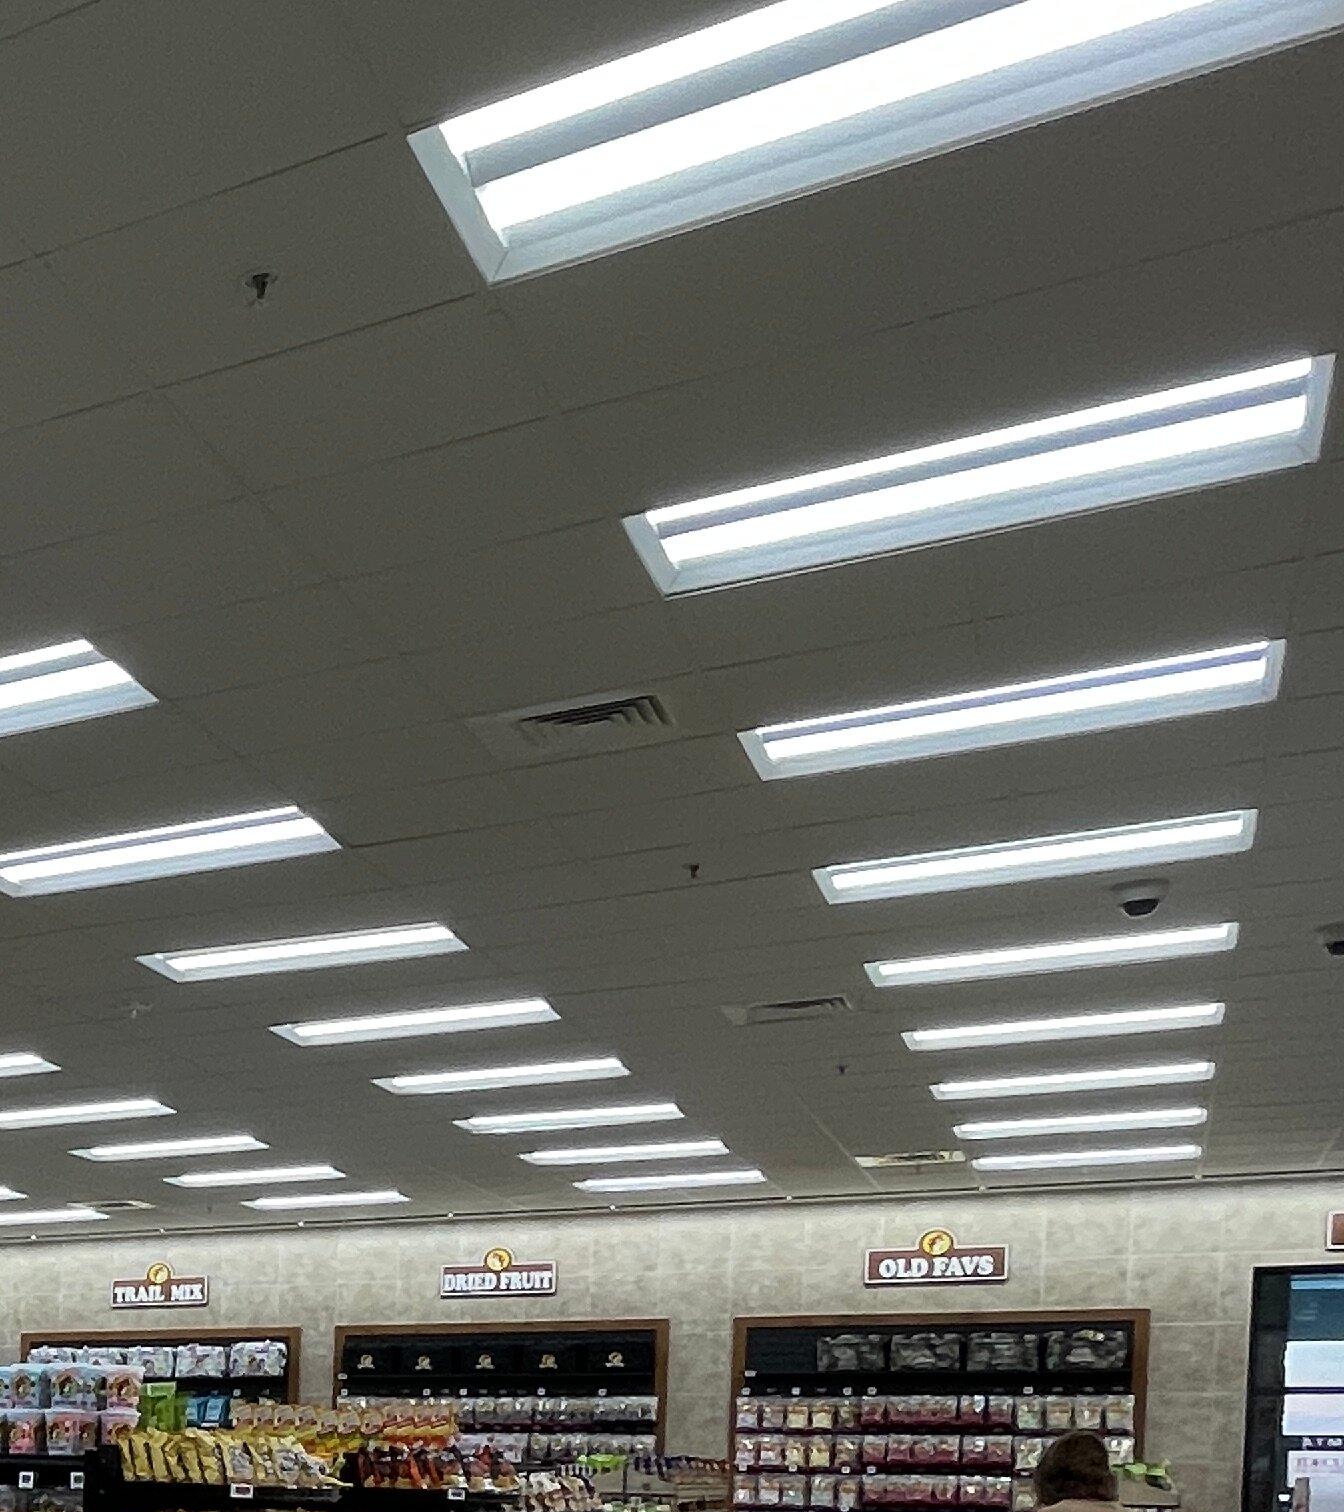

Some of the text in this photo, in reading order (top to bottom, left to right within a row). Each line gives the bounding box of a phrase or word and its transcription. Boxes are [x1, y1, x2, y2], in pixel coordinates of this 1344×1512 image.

[878, 1255, 994, 1278] OLD FAVS
[443, 1270, 552, 1291] DRIED FRUIT
[114, 1283, 203, 1304] TRAIL MIX
